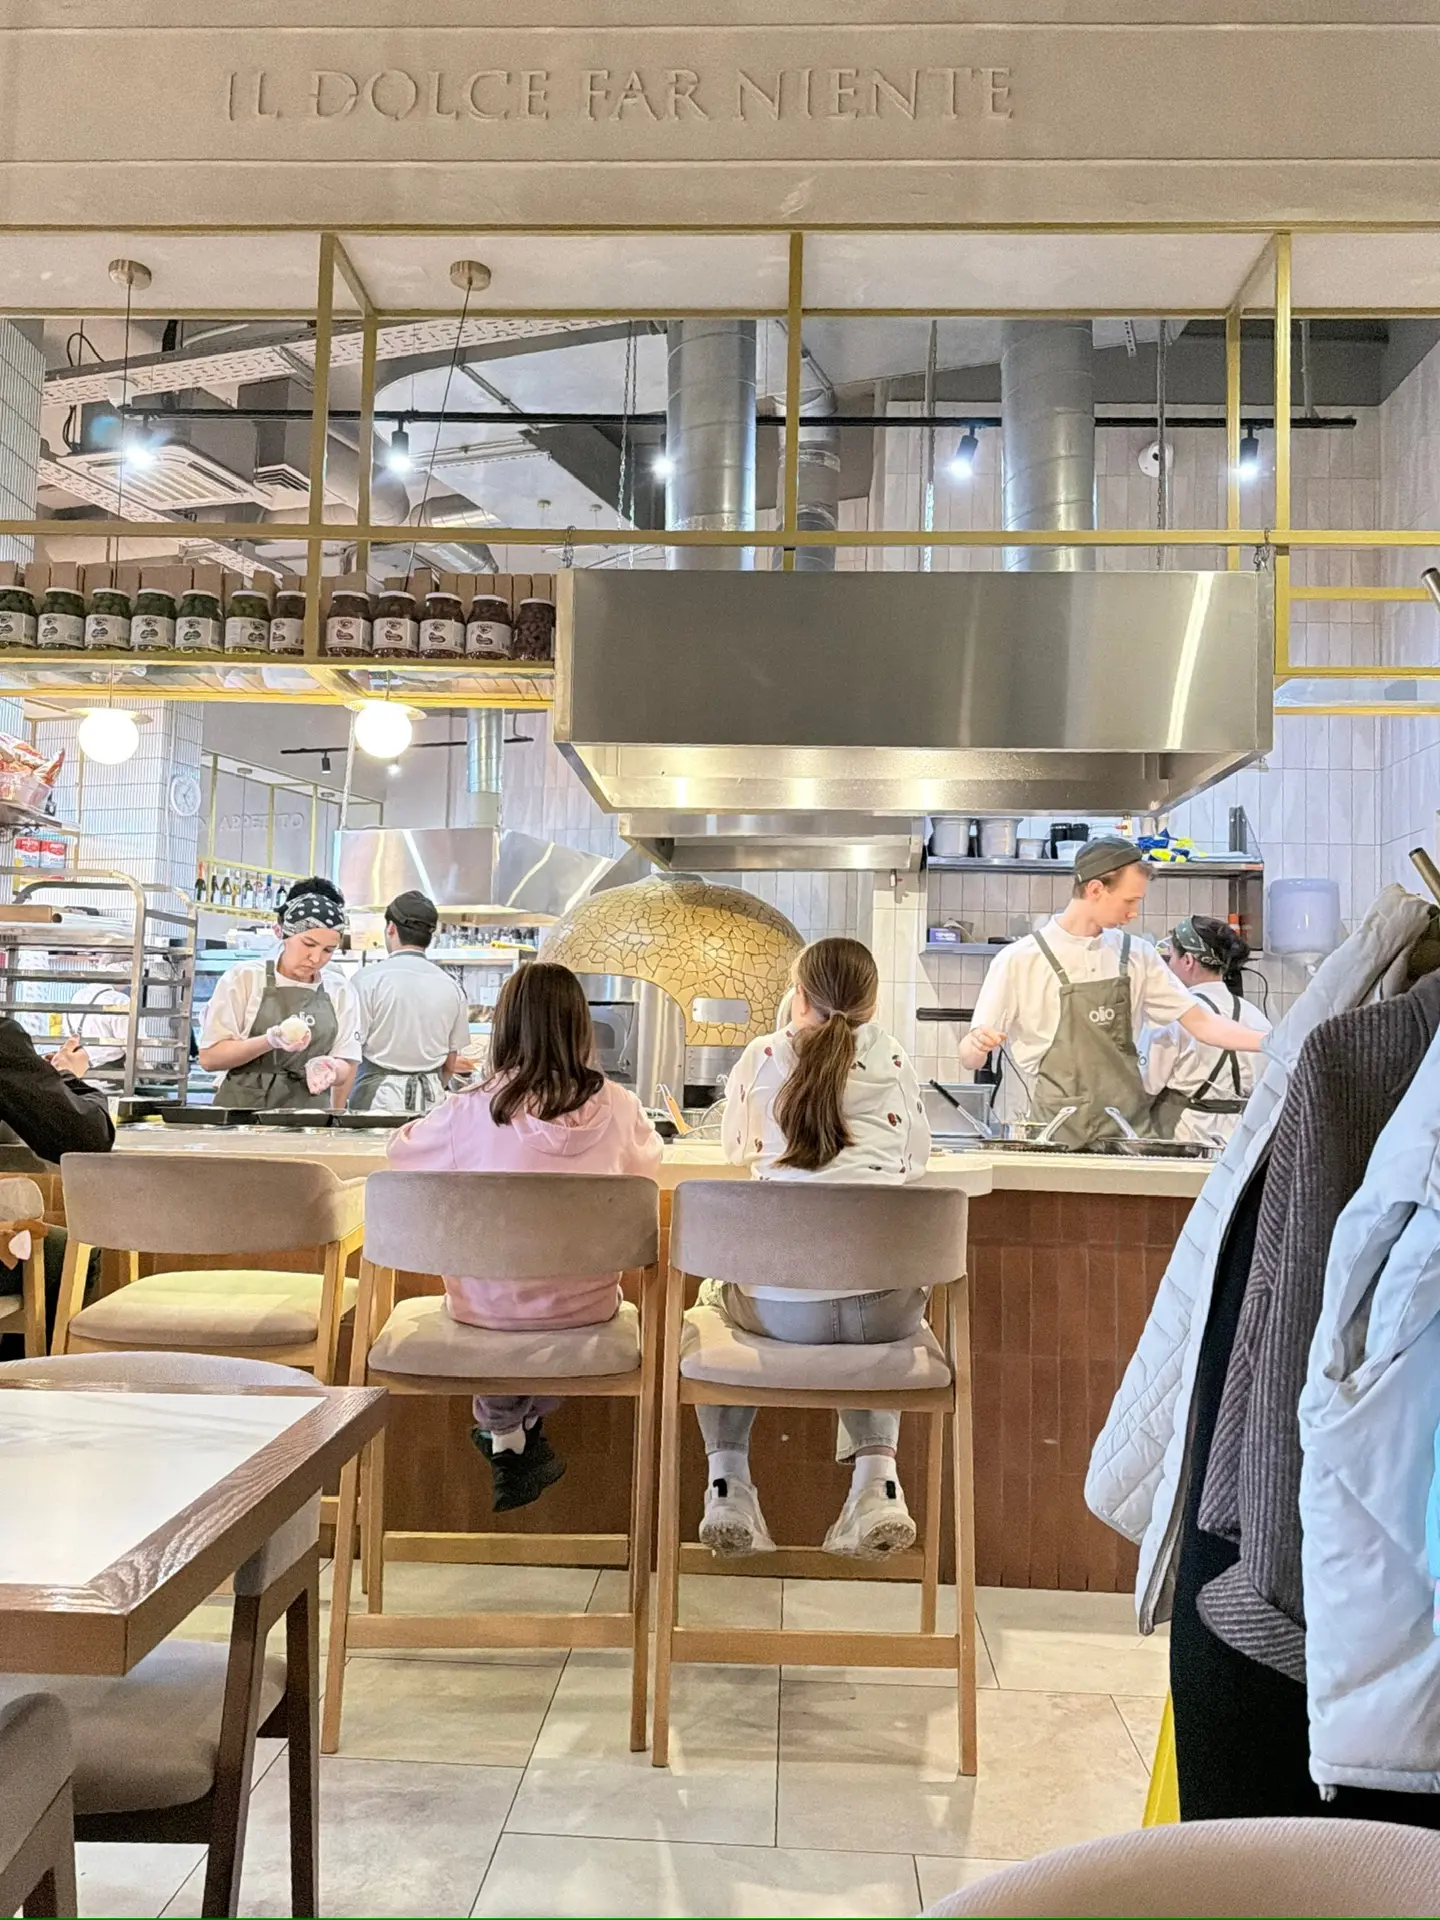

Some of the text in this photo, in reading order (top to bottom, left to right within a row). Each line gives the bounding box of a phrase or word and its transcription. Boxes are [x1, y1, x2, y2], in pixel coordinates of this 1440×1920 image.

[227, 66, 1014, 121] IL DOLCE FAR NIENTE
[1088, 1006, 1116, 1023] olio
